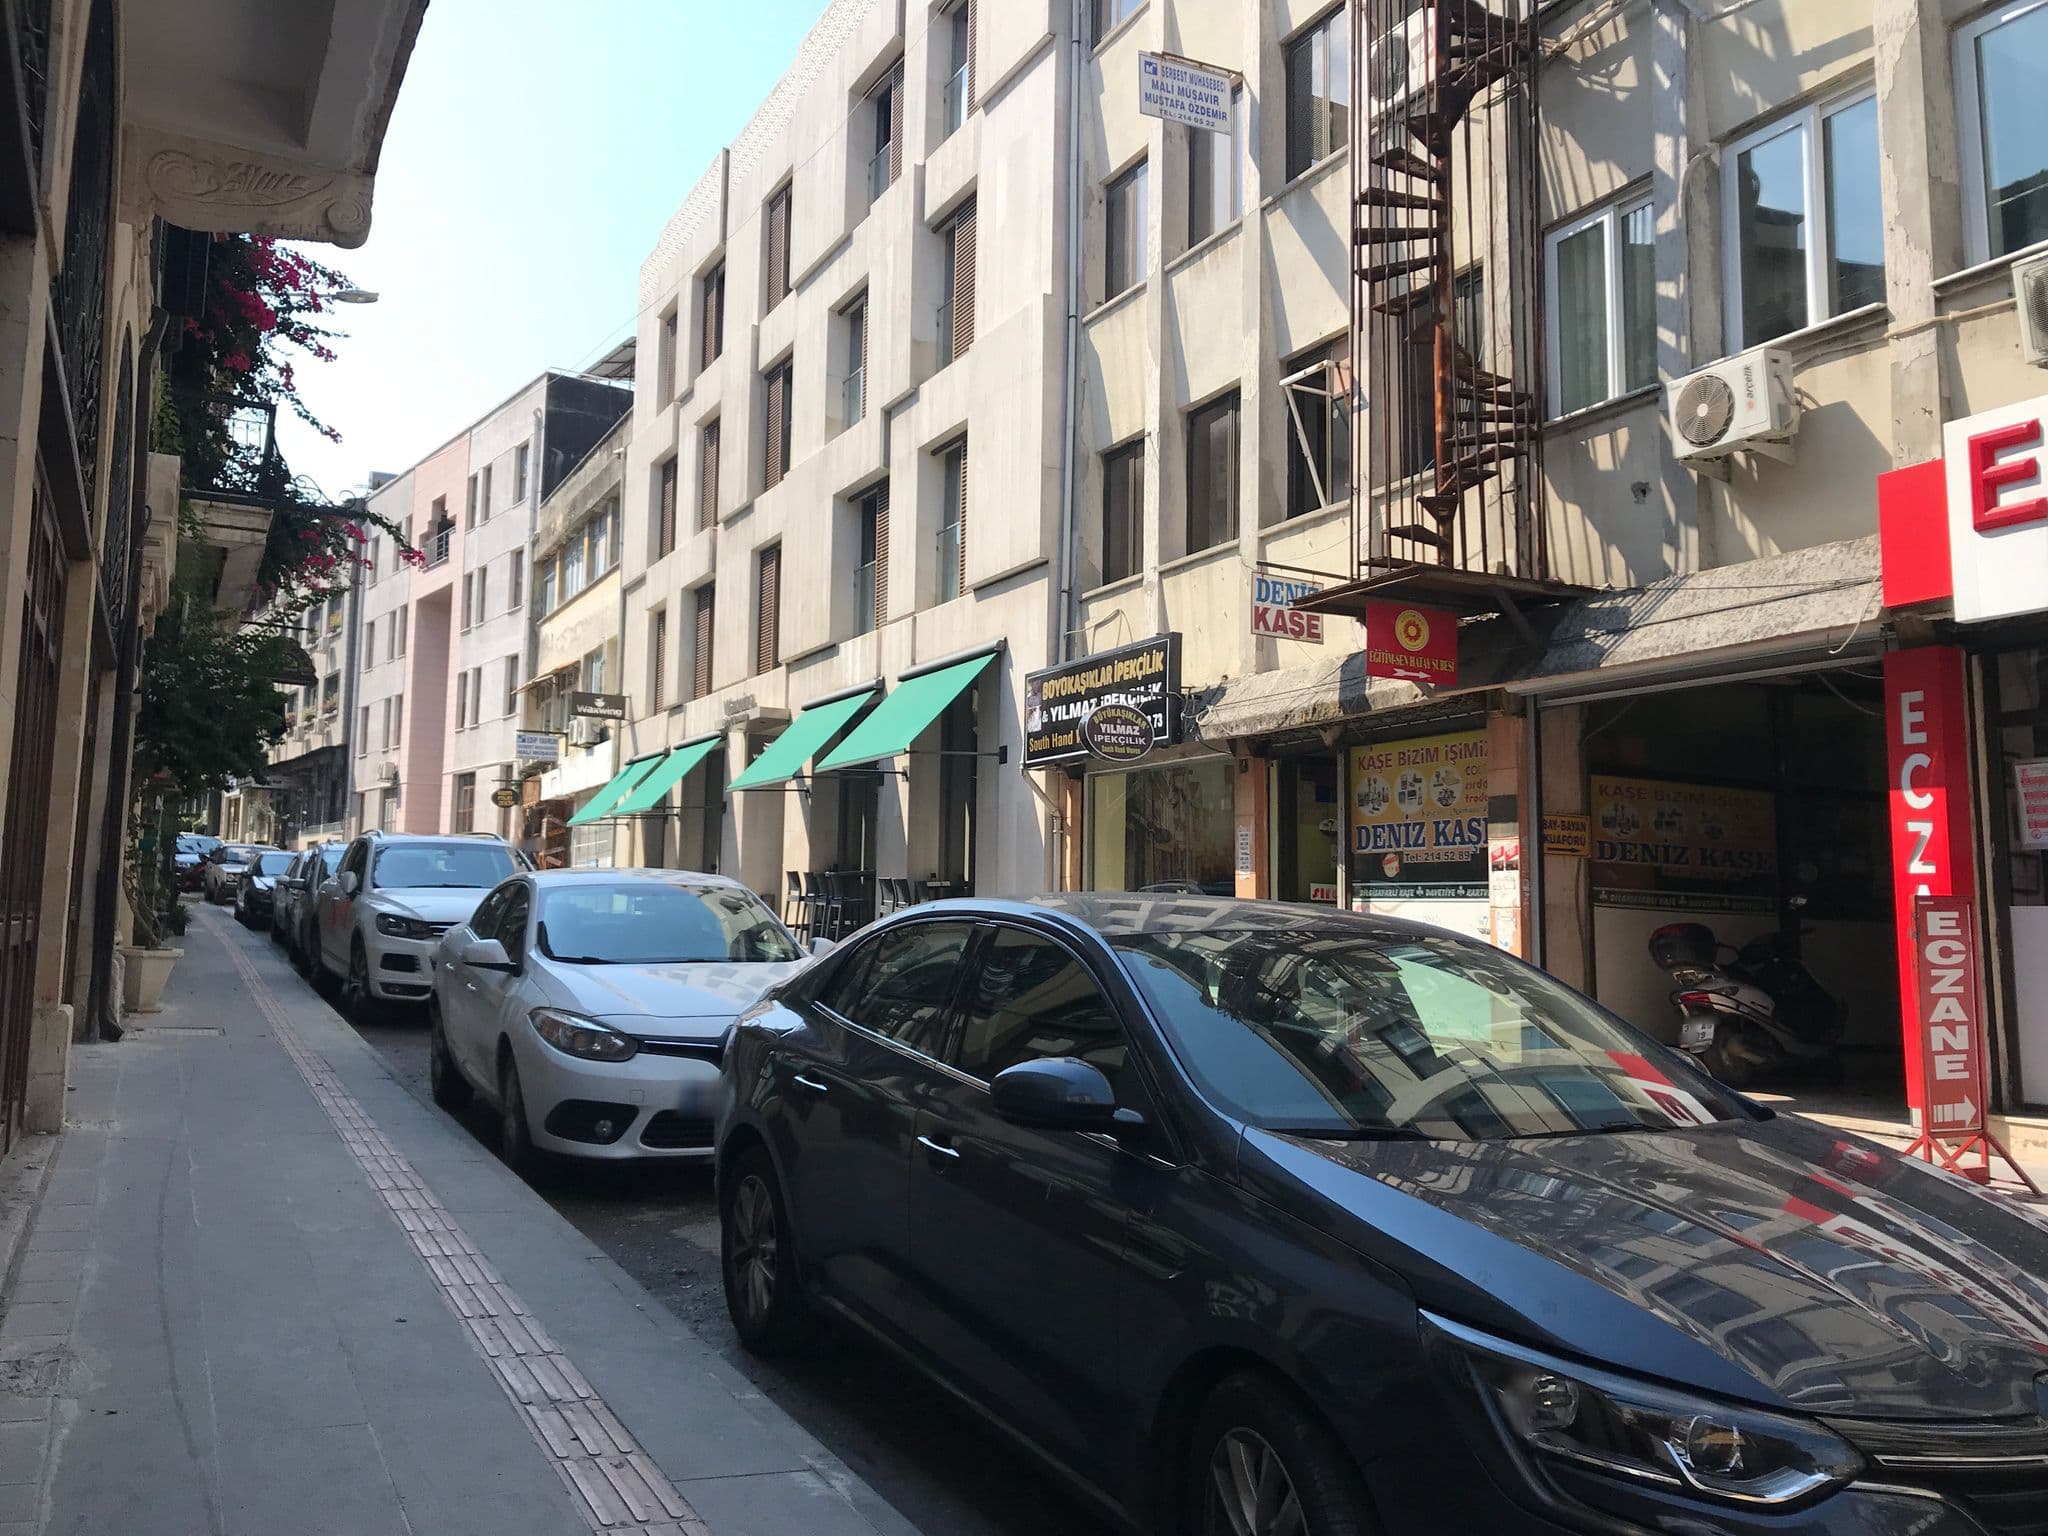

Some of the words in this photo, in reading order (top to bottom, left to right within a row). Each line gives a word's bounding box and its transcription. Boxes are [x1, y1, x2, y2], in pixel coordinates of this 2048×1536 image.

[1151, 79, 1174, 95] MALİ
[1144, 92, 1186, 110] MUSTAFA
[1256, 577, 1320, 606] DENİ
[1254, 606, 1321, 639] KAŞE
[1114, 649, 1164, 684] İPEKÇİLİK
[1050, 697, 1098, 723] YILMAZ
[1029, 735, 1050, 752] South
[1052, 730, 1073, 748] Hand
[1094, 734, 1146, 746] İPEKÇİLİK
[1099, 723, 1140, 736] YILMAZ
[1358, 753, 1393, 773] KAŞE
[1445, 740, 1488, 765] İŞİMİ
[1356, 814, 1426, 851] DENİZ
[1404, 853, 1422, 862] Tel:
[1424, 852, 1441, 861] 214
[1444, 852, 1456, 861] 52
[1459, 851, 1470, 860] 89
[1596, 838, 1690, 865] DENİZ
[1924, 910, 1970, 1081] ECZANE
